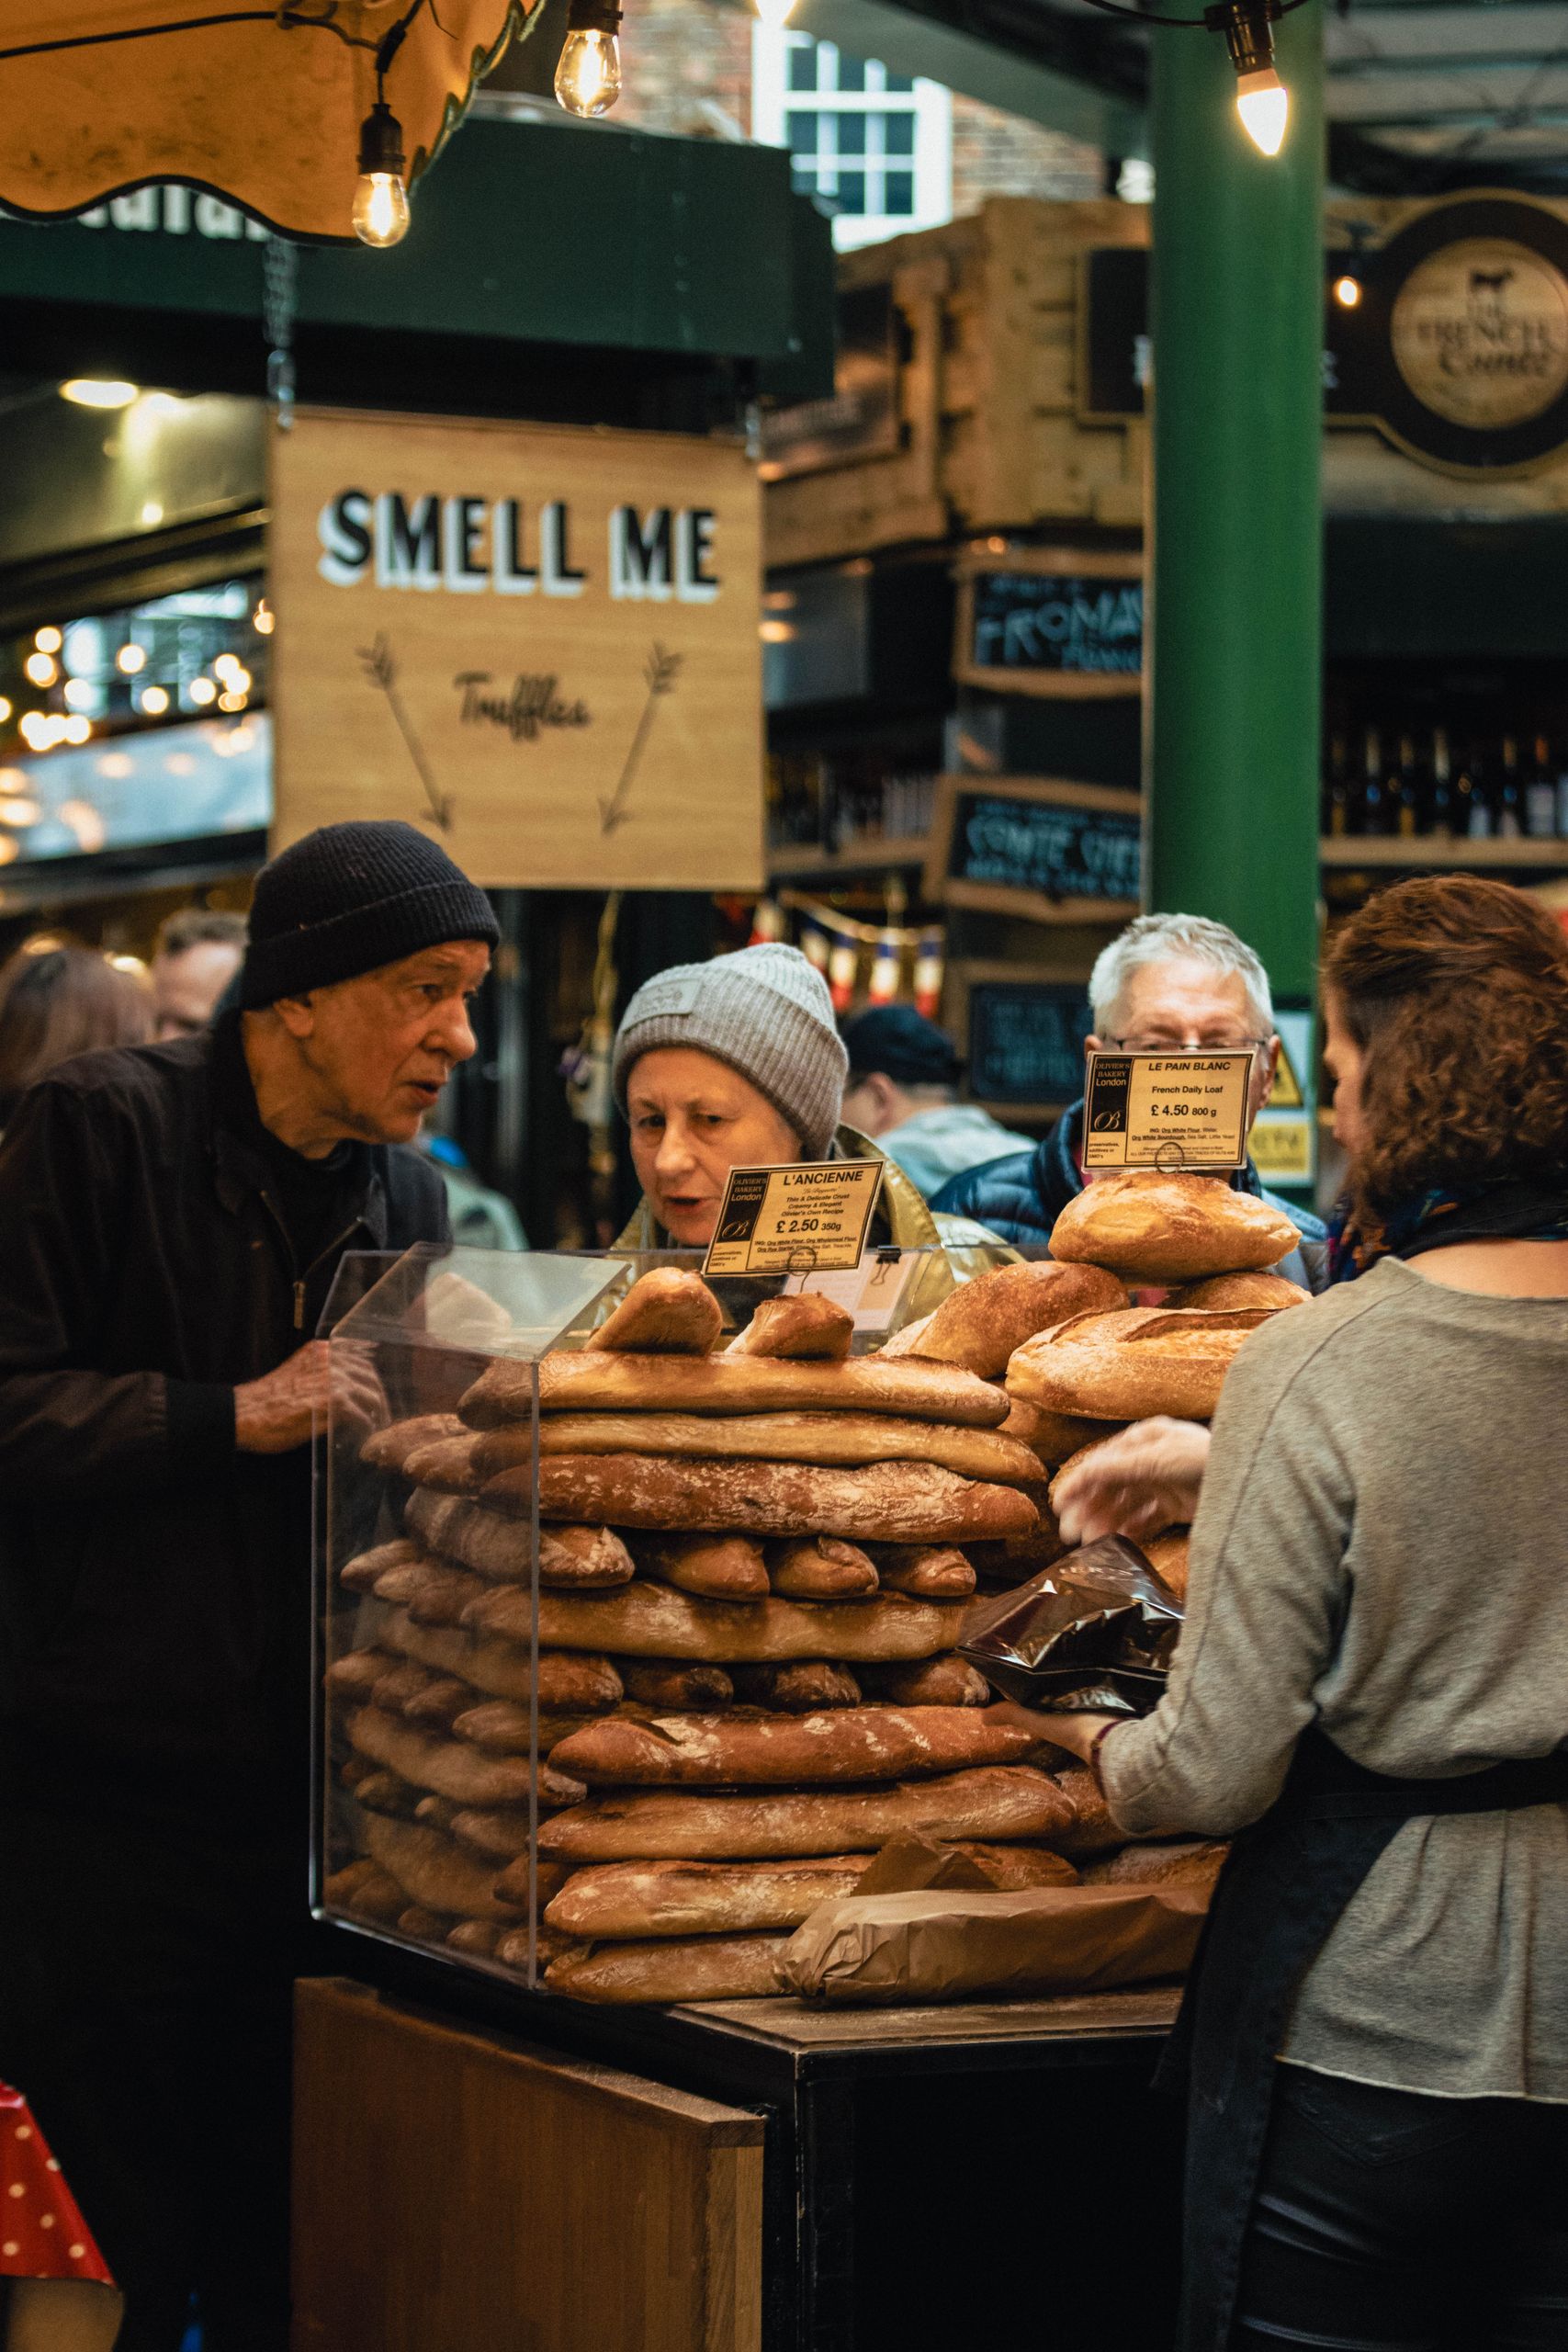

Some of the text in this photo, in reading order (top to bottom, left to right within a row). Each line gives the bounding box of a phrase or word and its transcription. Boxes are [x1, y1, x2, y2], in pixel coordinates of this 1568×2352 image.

[318, 487, 720, 604] SMELL ME
[455, 671, 591, 742] Truffles
[1148, 1062, 1231, 1071] LE PAIN BLANC
[1096, 1078, 1127, 1086] London
[1182, 1086, 1202, 1095] Daily
[1151, 1104, 1217, 1118] £ 4.50 800 g
[783, 1170, 864, 1186] L'ANCIENNE
[776, 1218, 841, 1233] £ 2.50 350g
